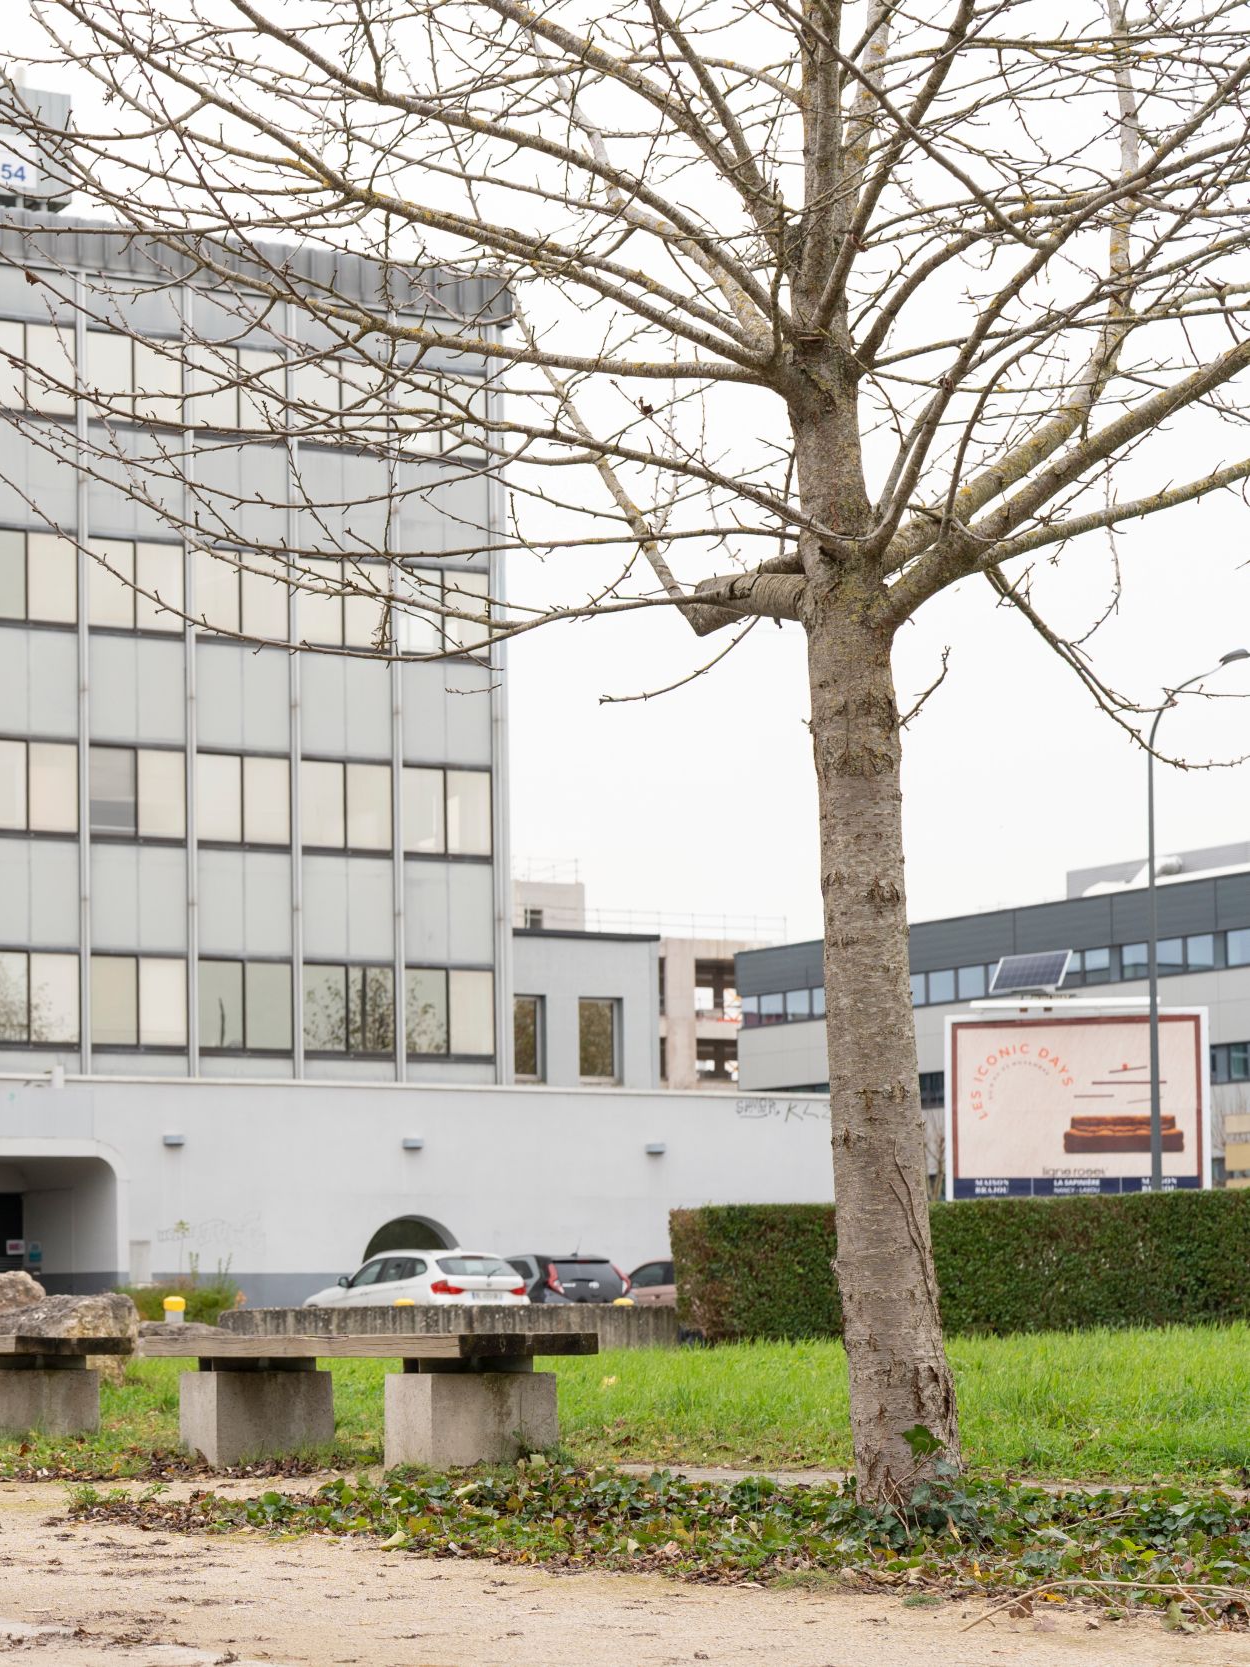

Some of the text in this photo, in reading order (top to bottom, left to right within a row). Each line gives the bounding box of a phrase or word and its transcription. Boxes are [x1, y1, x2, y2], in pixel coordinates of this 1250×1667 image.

[1, 163, 26, 182] 54
[973, 1043, 1030, 1082] ICONIC
[1038, 1047, 1073, 1086] DAYS
[970, 1090, 989, 1120] LES
